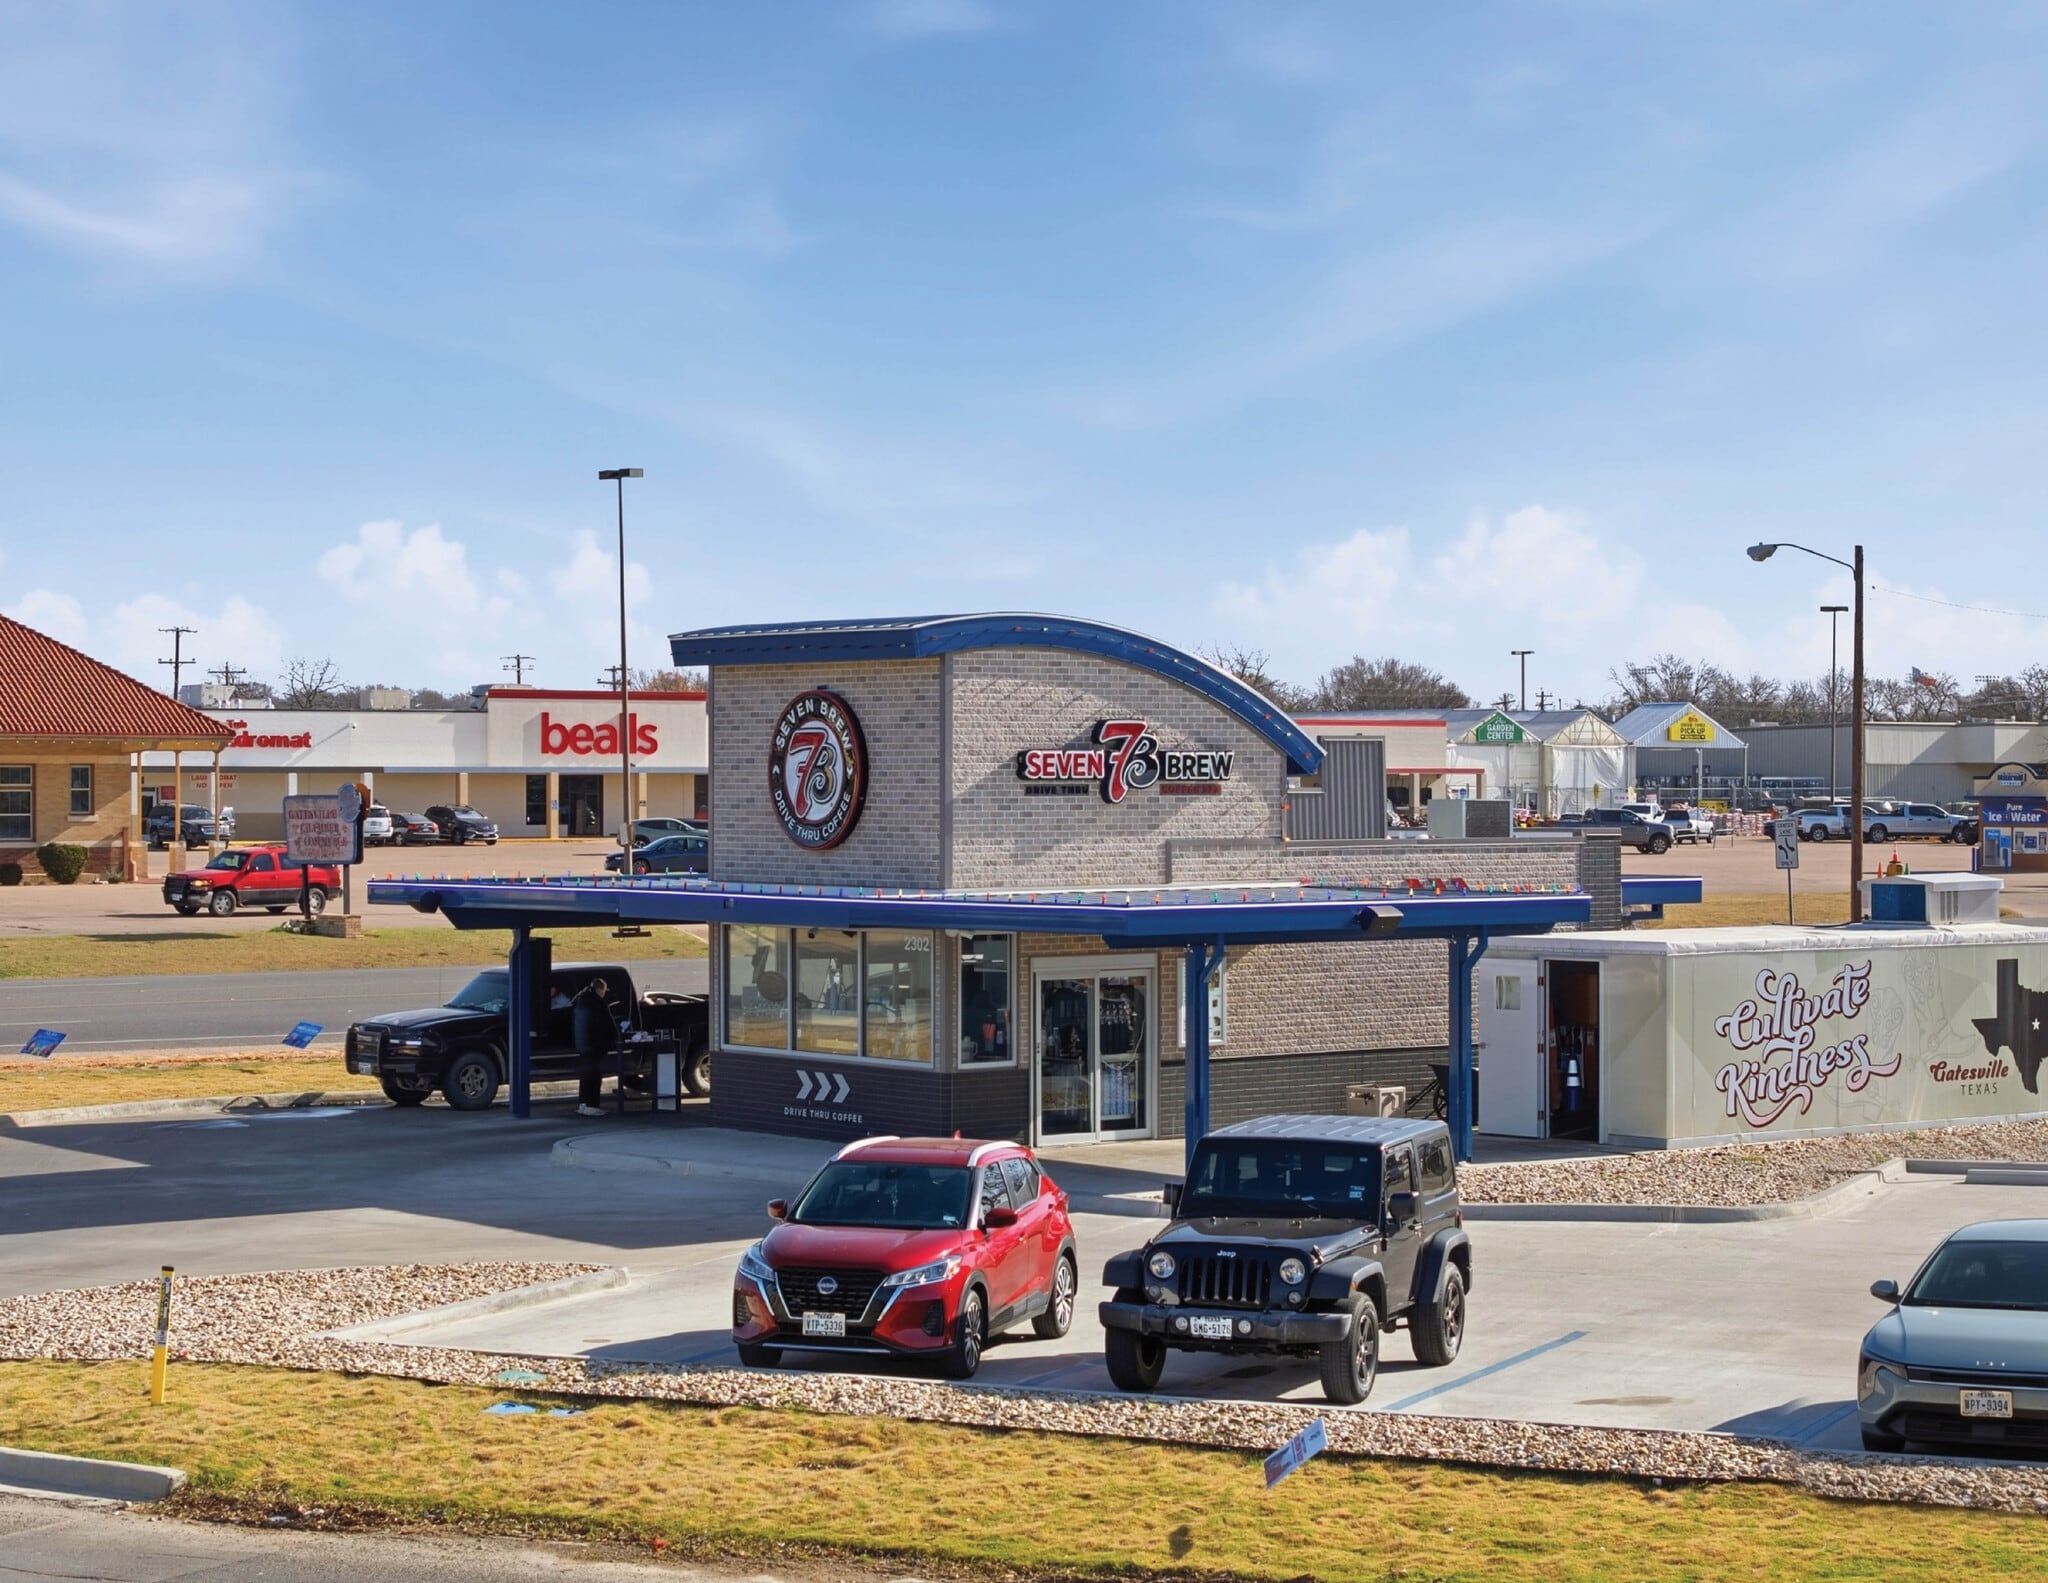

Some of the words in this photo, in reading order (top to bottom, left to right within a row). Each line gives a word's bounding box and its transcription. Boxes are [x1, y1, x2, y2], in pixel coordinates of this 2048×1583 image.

[776, 699, 814, 749] SEVEN
[819, 701, 853, 749] BREW
[1486, 723, 1515, 731] GARDEN
[1680, 727, 1696, 735] PICK
[1696, 727, 1706, 735] UP
[231, 730, 312, 748] dromat
[541, 712, 658, 755] bealls
[1486, 731, 1514, 740] CENTER
[1026, 749, 1105, 779] SEVEN
[1165, 750, 1235, 780] BREW
[1025, 785, 1056, 795] DRIVE
[1061, 785, 1089, 795] THRU
[775, 789, 795, 830] DRIVE
[796, 826, 821, 841] THRU
[822, 791, 851, 837] COFFEE
[2006, 803, 2023, 811] Pure
[1988, 811, 2002, 822] Ice
[2010, 811, 2041, 822] Water
[904, 935, 930, 952] 2302
[1714, 960, 1873, 1050] Cultivate
[1714, 1026, 1902, 1128] Kindness
[1930, 1058, 2009, 1084] Gatesville
[1960, 1083, 1999, 1097] TEXAS
[783, 1106, 808, 1118] DRIVE
[809, 1109, 831, 1120] THRU
[832, 1112, 863, 1124] COFFEE
[1216, 1249, 1237, 1258] Jeep
